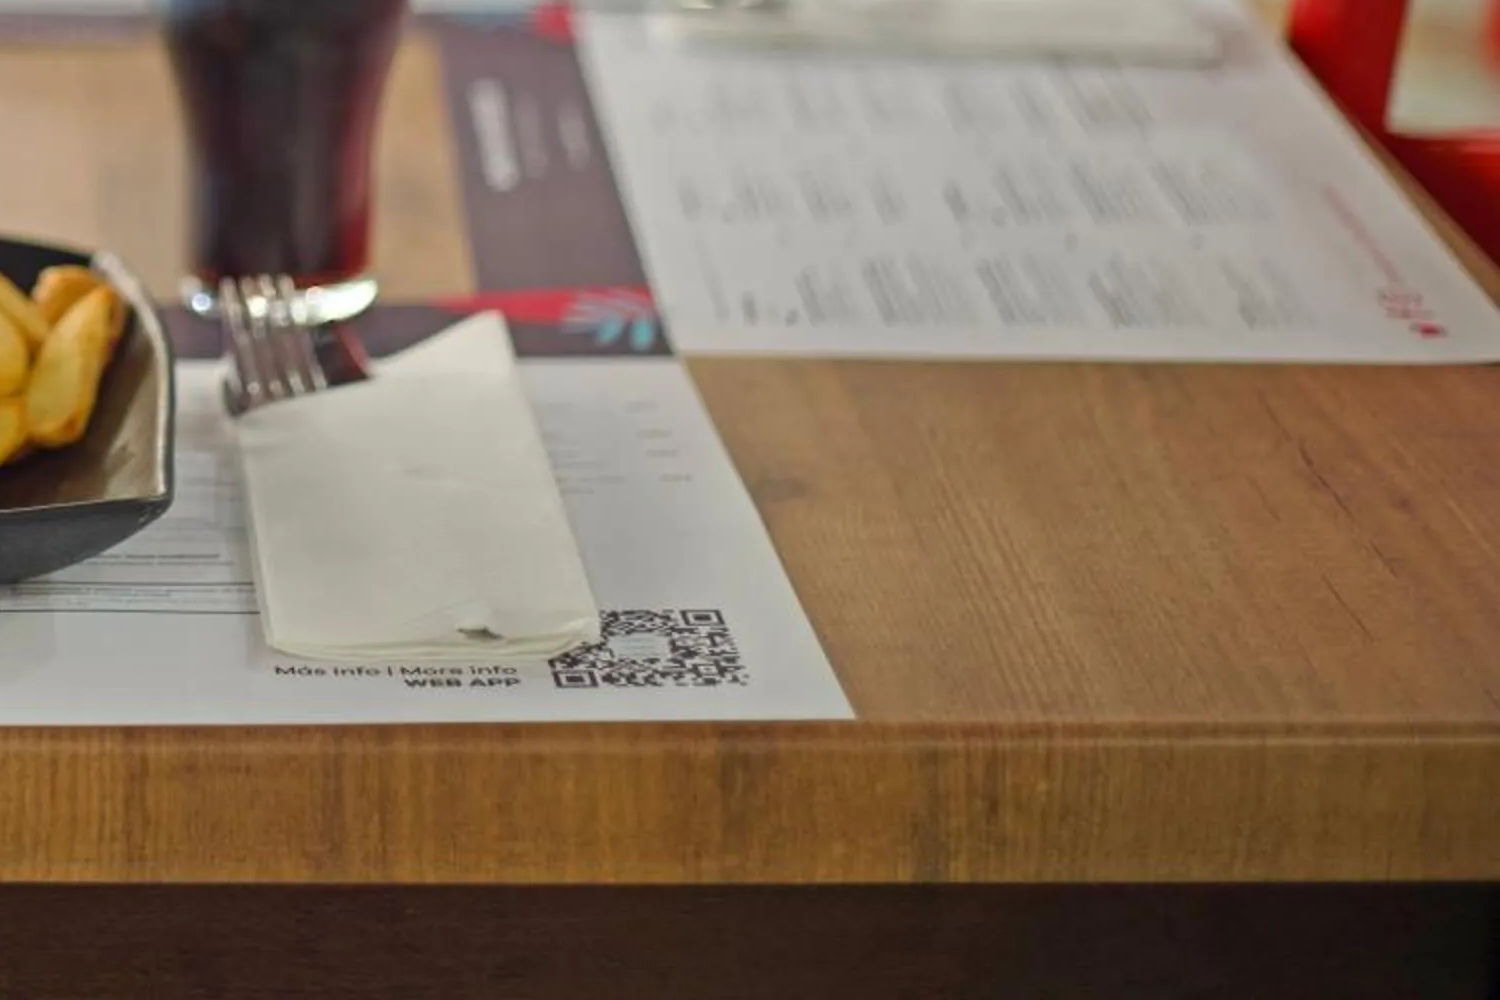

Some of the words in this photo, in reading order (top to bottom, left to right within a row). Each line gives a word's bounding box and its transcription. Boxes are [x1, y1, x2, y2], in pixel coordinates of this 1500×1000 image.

[332, 666, 381, 676] info
[400, 666, 463, 676] More
[468, 665, 518, 676] info
[403, 678, 462, 688] WEB
[469, 677, 521, 688] APP
